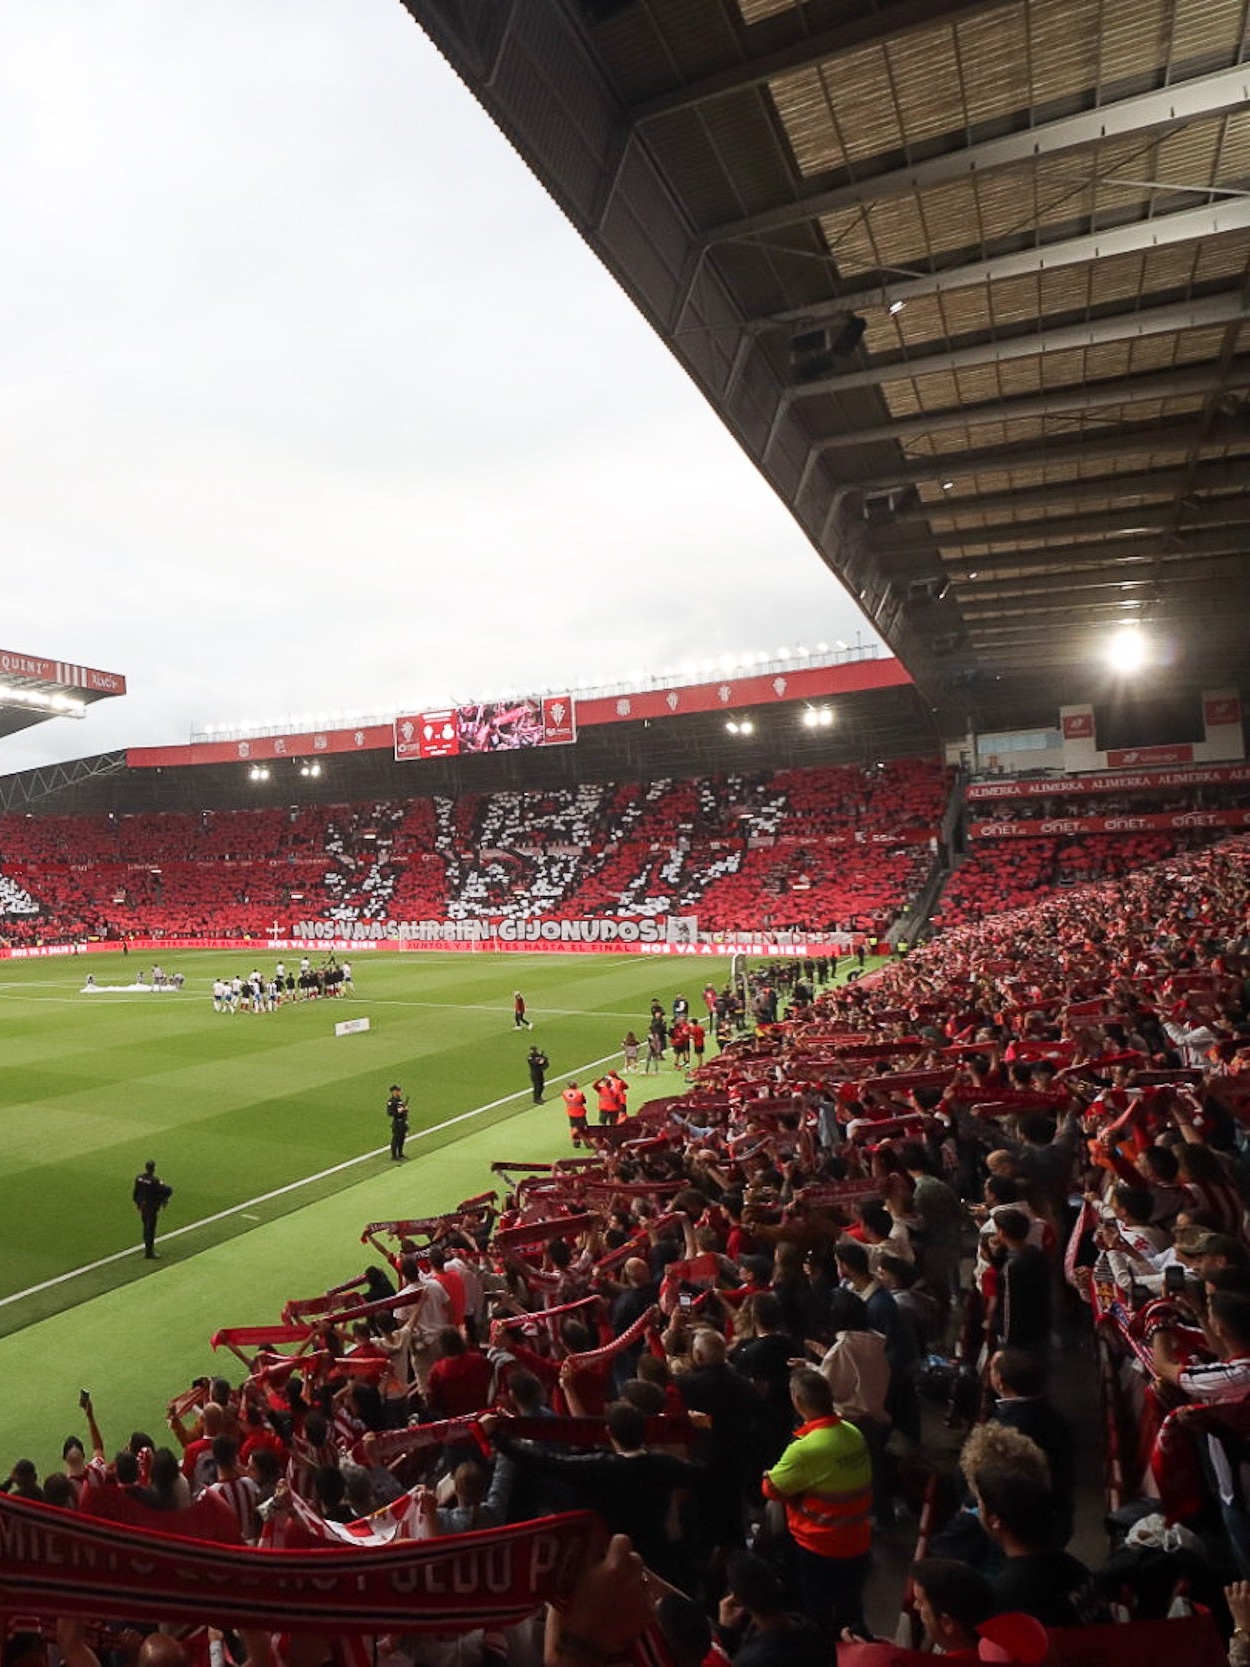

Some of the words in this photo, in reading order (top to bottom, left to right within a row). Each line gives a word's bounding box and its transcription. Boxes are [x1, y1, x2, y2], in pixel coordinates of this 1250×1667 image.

[498, 918, 660, 942] GIJONUDOS
[268, 940, 289, 948] NOS
[291, 940, 304, 948] VA
[641, 944, 671, 954] NOS
[677, 944, 698, 954] VA
[717, 945, 763, 956] SALIR
[768, 945, 807, 956] BIEN
